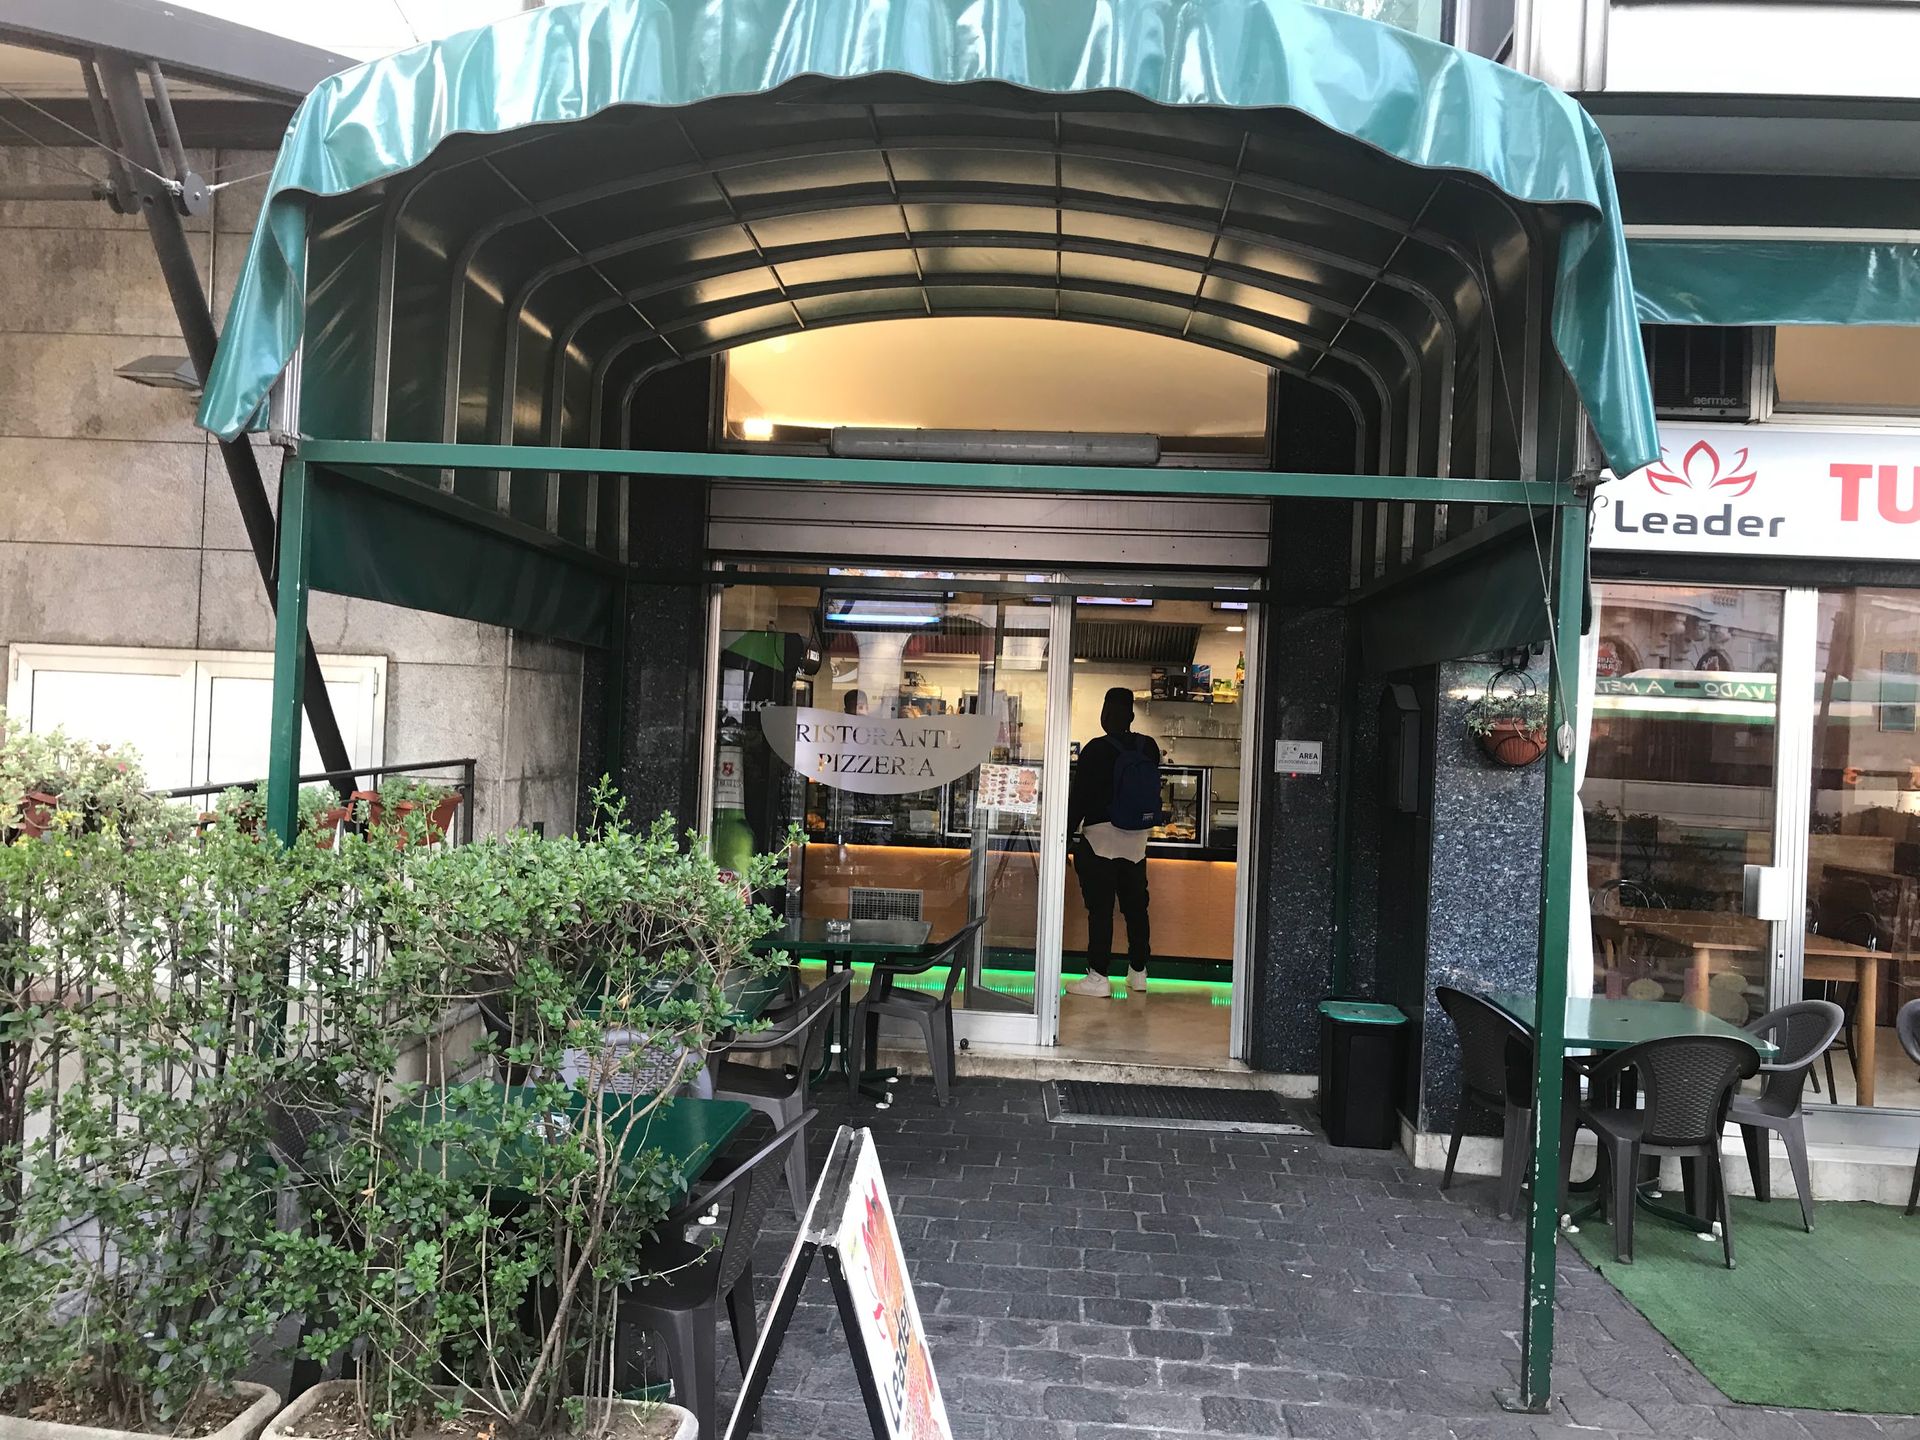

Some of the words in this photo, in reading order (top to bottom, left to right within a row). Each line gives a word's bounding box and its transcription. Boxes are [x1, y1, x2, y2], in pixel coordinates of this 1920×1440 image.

[1693, 396, 1737, 406] aermec
[1614, 500, 1785, 537] Leader
[796, 724, 961, 749] RISTORANTE
[818, 753, 935, 776] PIZZERIA
[1299, 752, 1318, 760] AREA
[884, 1296, 911, 1434] Leader
